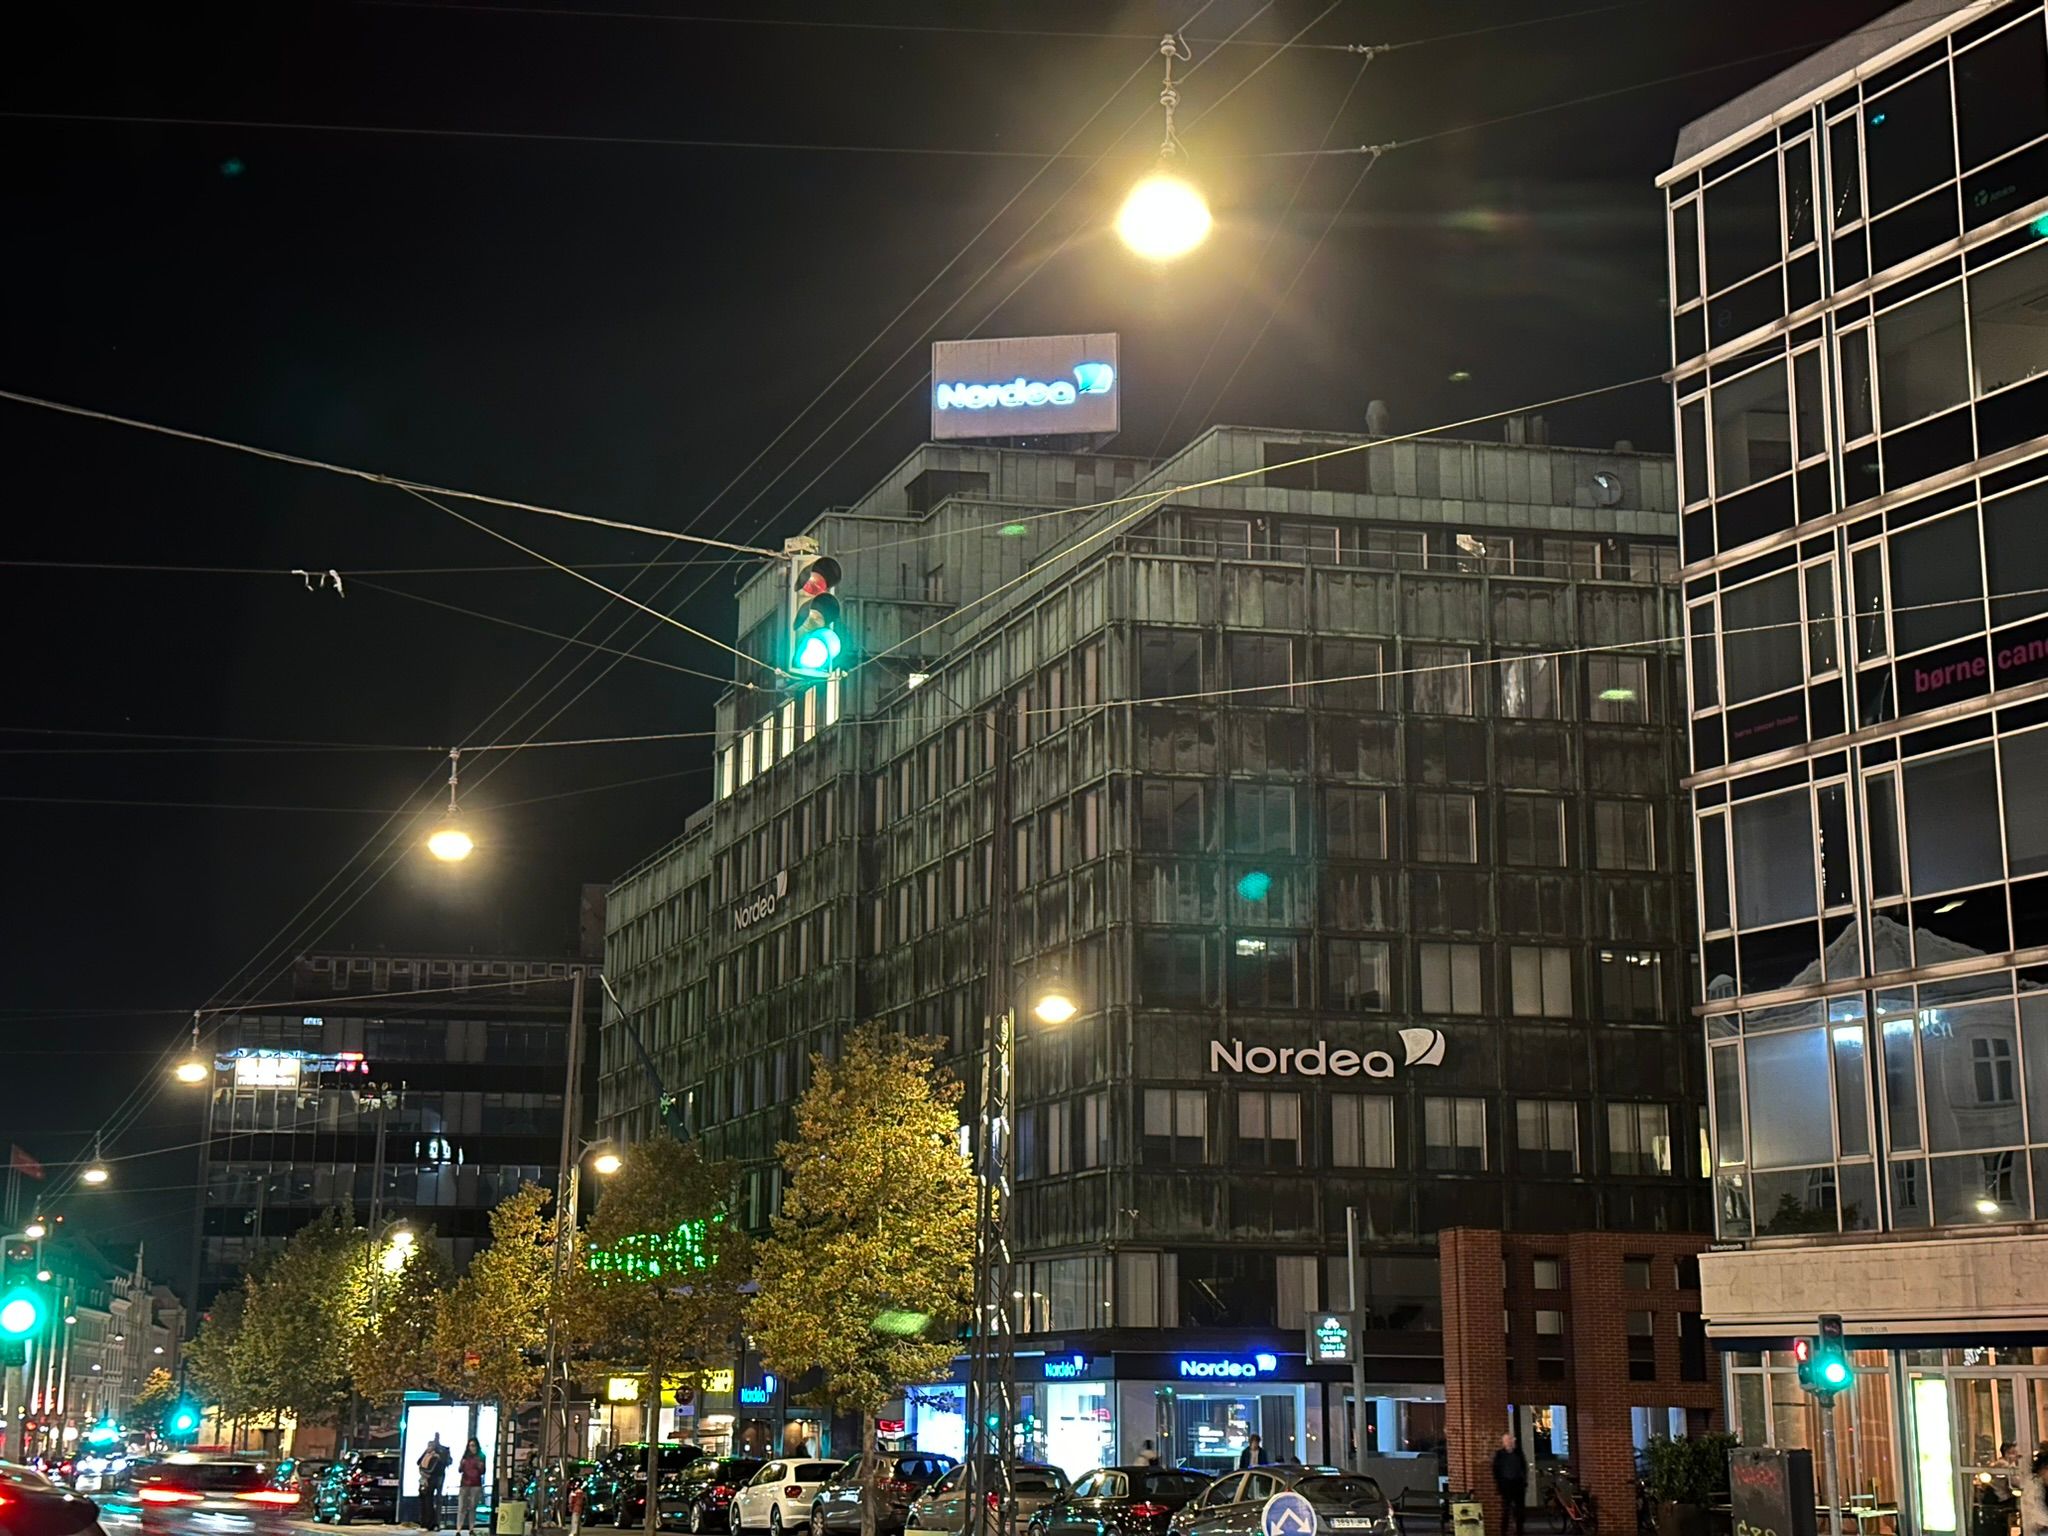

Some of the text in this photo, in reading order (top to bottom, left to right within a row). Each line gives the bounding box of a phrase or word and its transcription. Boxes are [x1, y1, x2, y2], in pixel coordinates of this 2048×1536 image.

[937, 377, 1076, 410] Nordea
[1914, 657, 1986, 693] børne
[734, 895, 776, 932] Nordea
[1210, 1039, 1395, 1078] Nordea
[1045, 1361, 1075, 1377] Nordea
[1180, 1360, 1256, 1376] Nordea
[741, 1386, 766, 1403] Nordea
